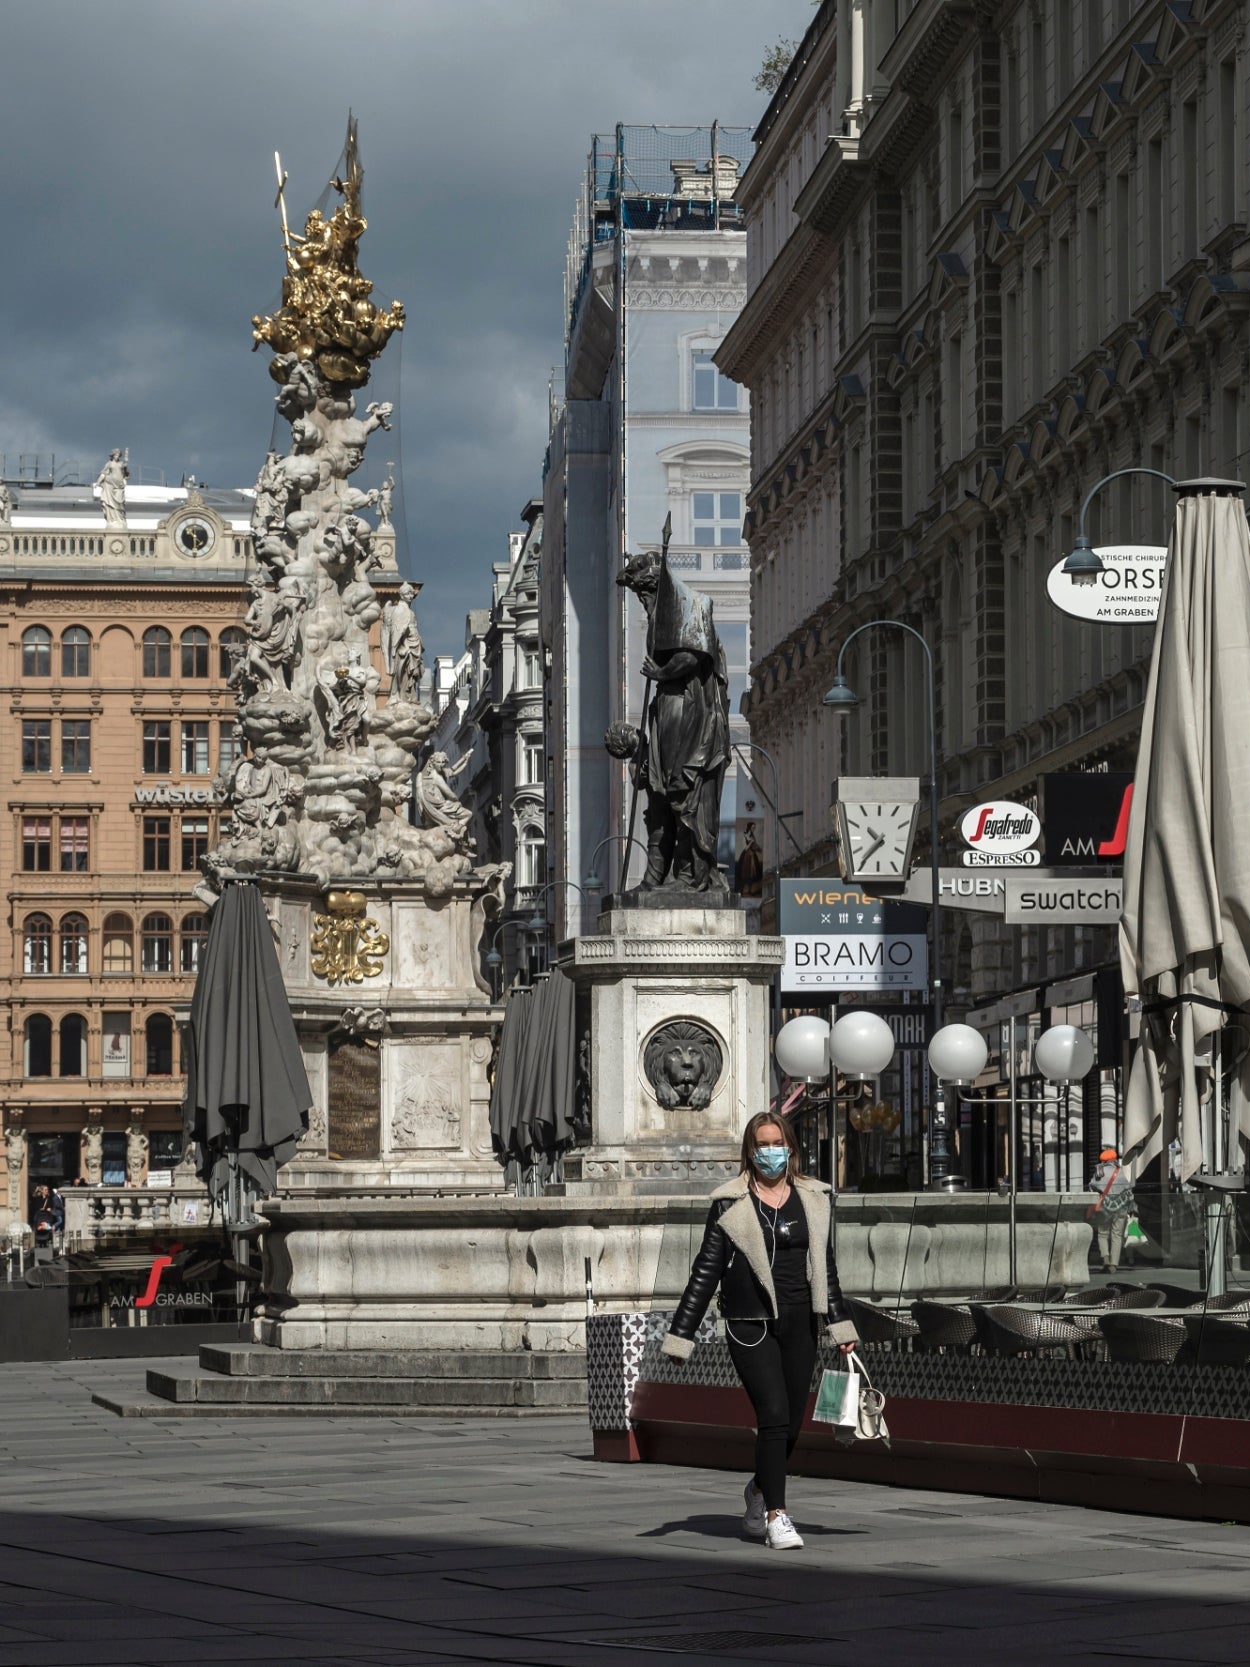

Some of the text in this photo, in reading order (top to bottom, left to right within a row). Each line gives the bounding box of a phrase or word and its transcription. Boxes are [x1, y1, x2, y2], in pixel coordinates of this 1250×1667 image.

[1105, 595, 1160, 603] ZAHNMEDIZIN
[1097, 608, 1154, 617] AM GRABEN
[969, 808, 1034, 842] Segafredo
[1061, 838, 1095, 856] AM
[968, 852, 1035, 865] ESPRESSO
[1020, 889, 1120, 910] swatch
[794, 941, 913, 967] BRAMO
[110, 1297, 135, 1308] AM
[155, 1291, 213, 1307] GRABEN
